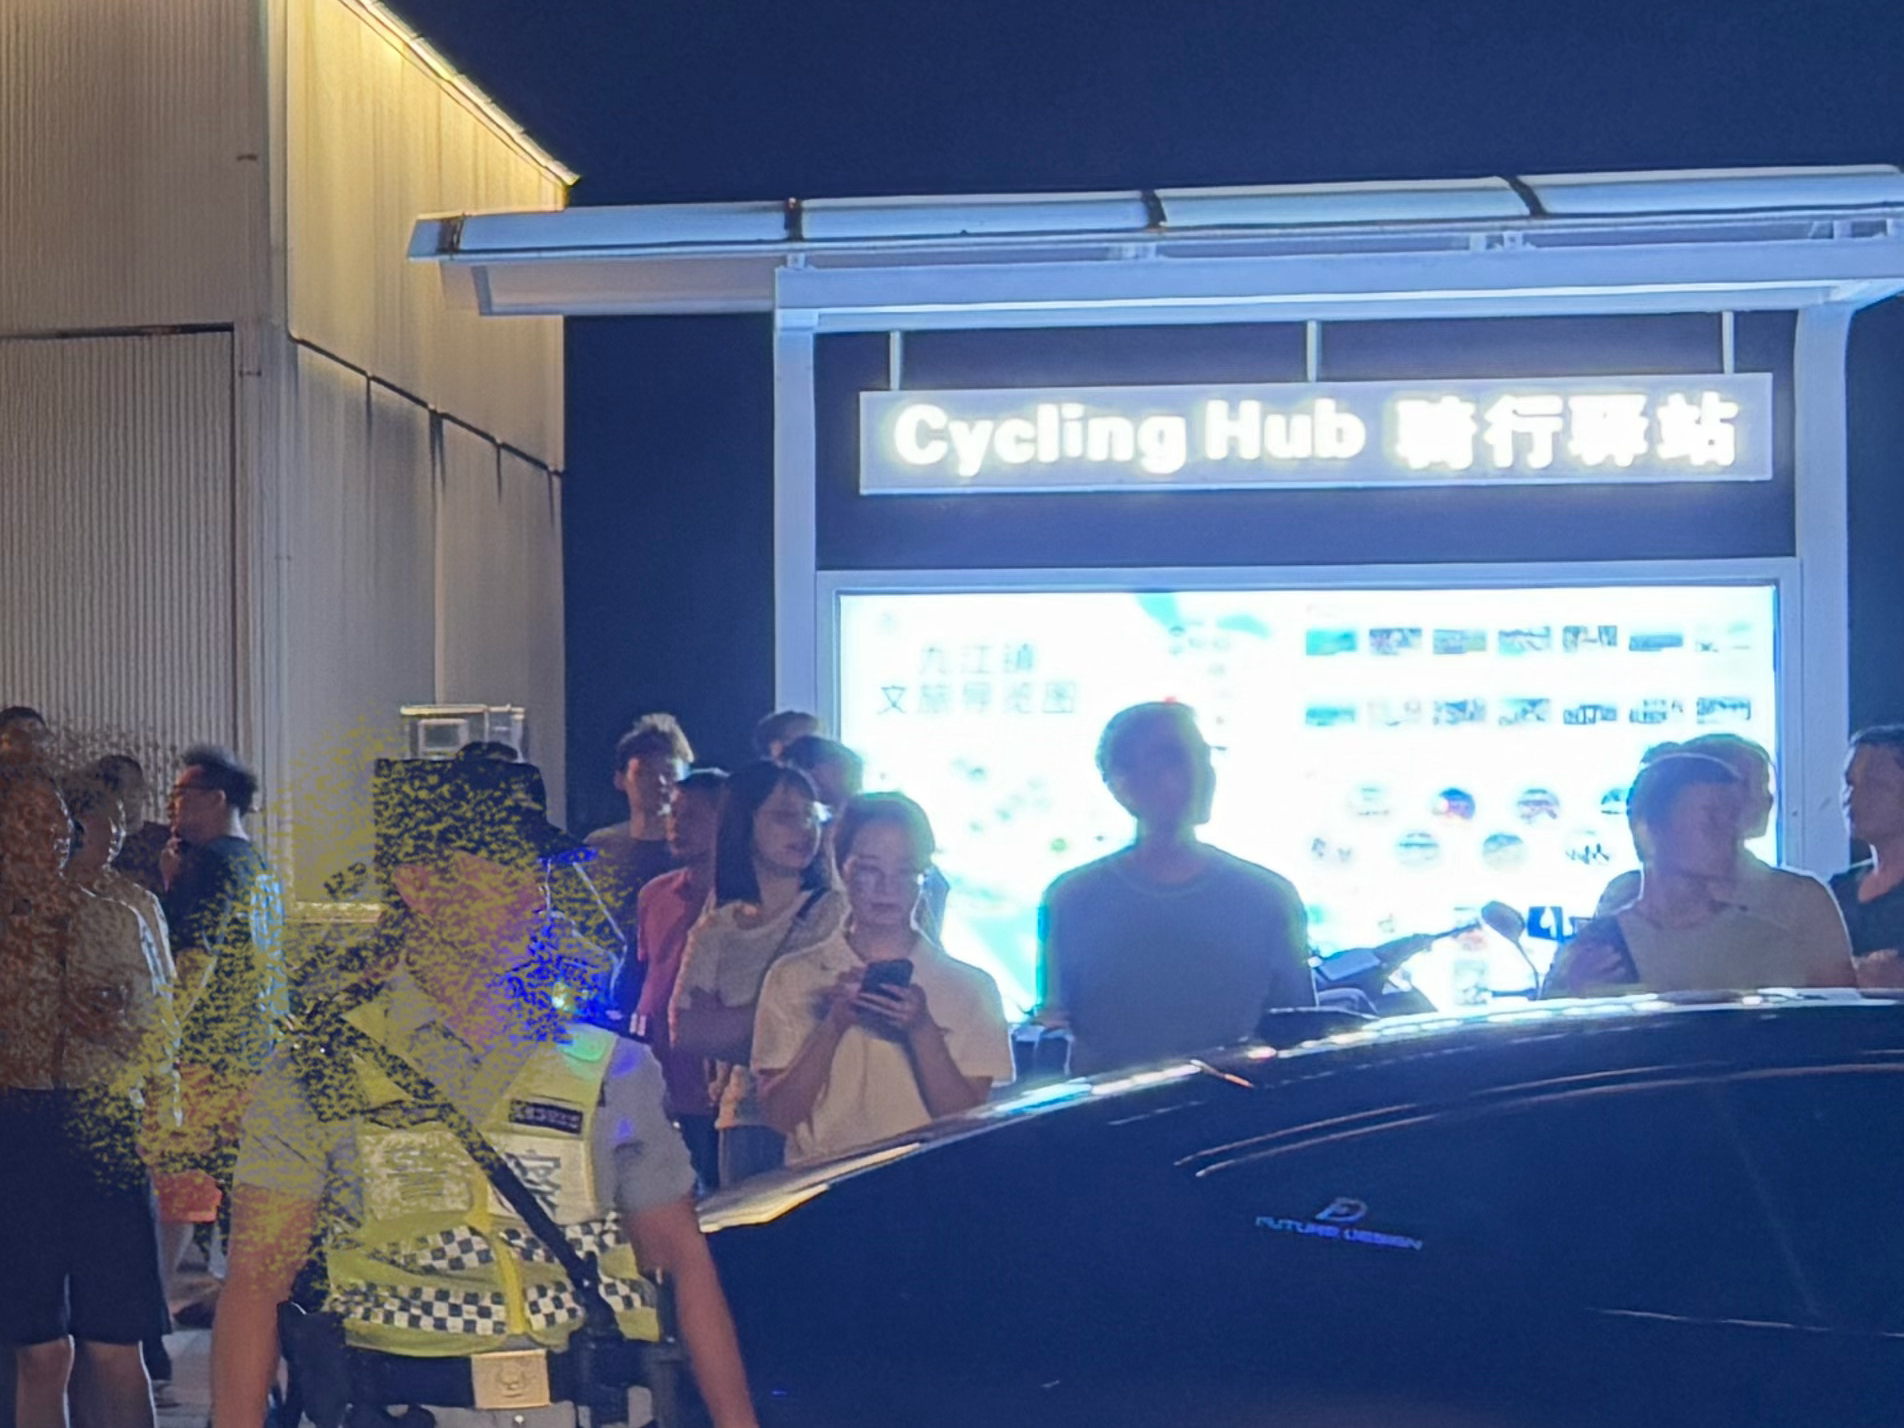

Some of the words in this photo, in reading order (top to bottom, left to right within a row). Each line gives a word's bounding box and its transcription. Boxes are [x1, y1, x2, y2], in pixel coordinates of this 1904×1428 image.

[894, 400, 1187, 478] Cycling
[1204, 397, 1367, 460] Hub
[1395, 391, 1740, 470] 骑行驿站
